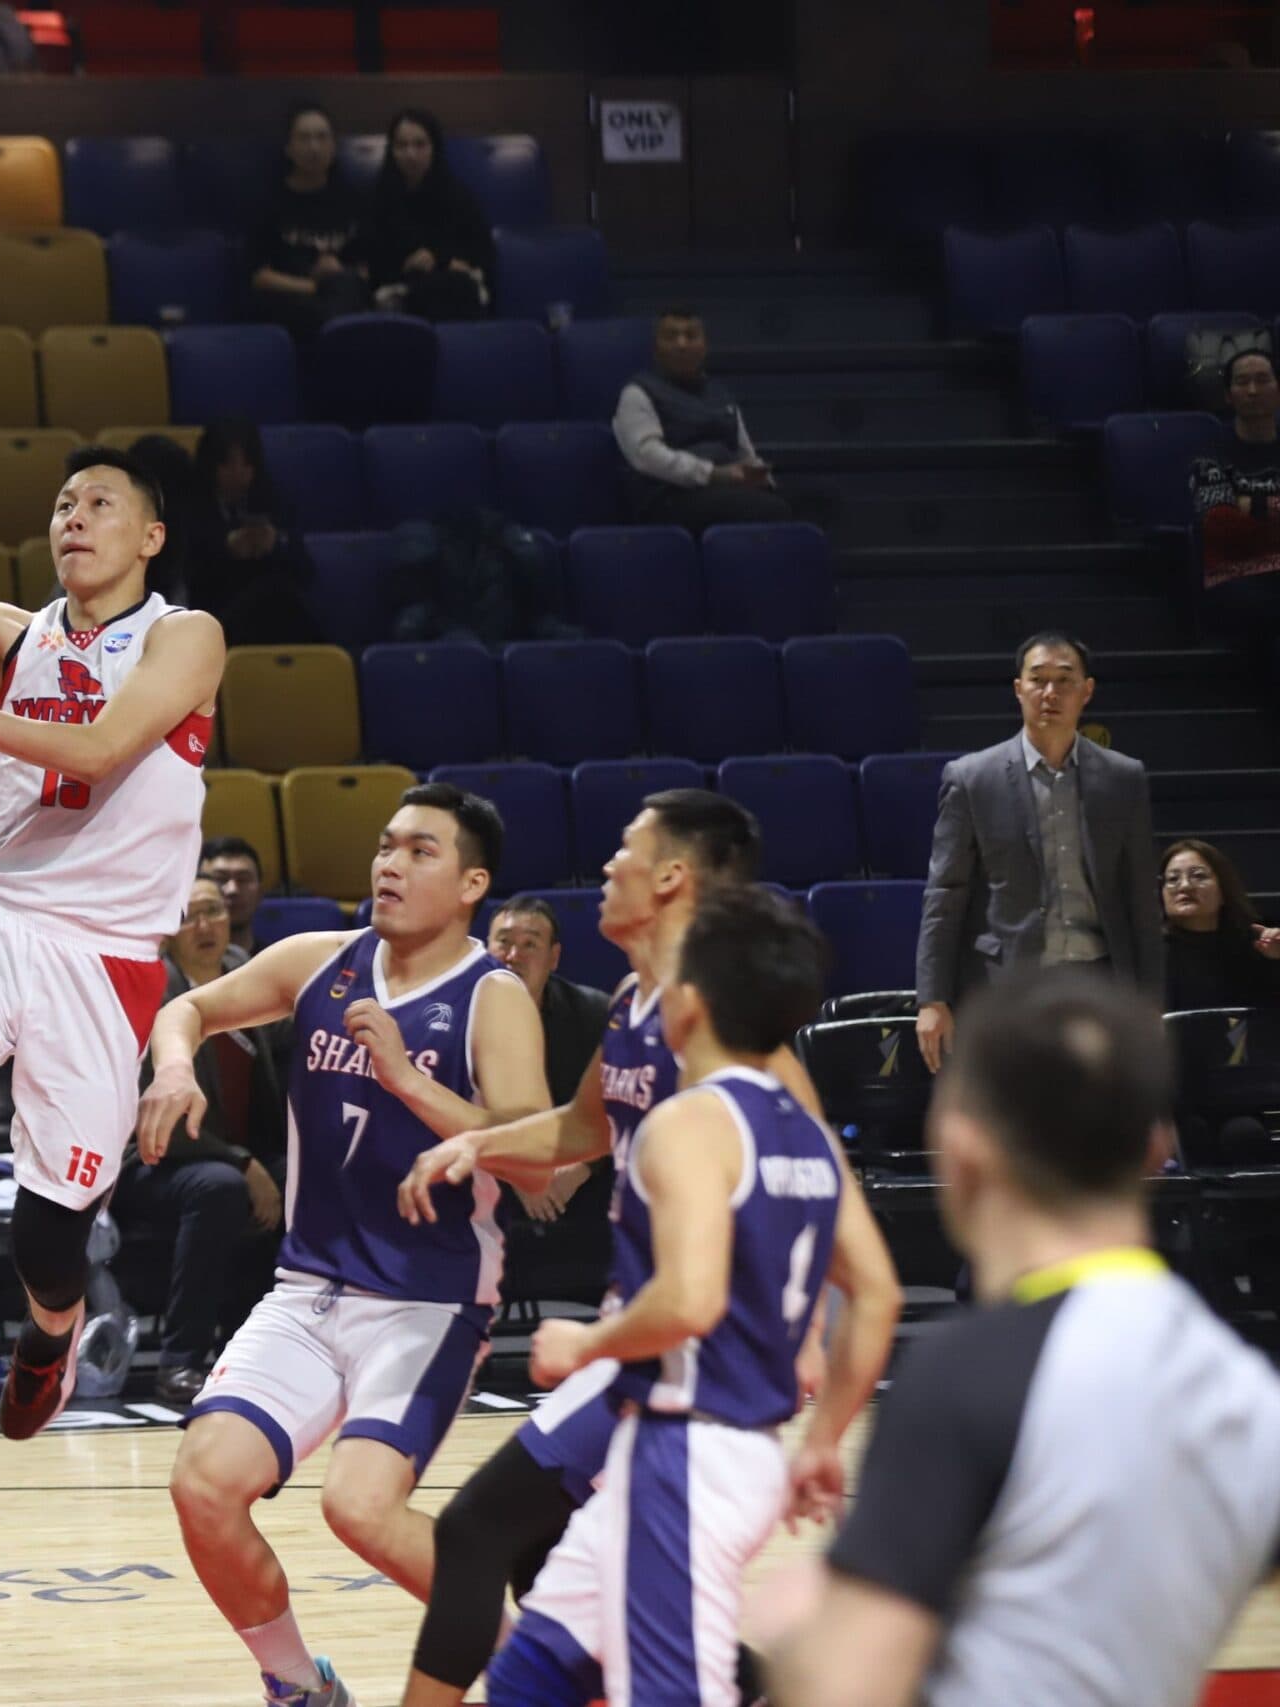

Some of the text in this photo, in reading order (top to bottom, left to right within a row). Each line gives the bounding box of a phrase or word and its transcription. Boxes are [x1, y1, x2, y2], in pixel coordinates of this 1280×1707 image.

[607, 109, 673, 129] ONLY
[624, 132, 664, 152] VIP
[307, 1028, 439, 1080] SHAS
[341, 1101, 371, 1169] 7
[65, 1145, 104, 1189] 15
